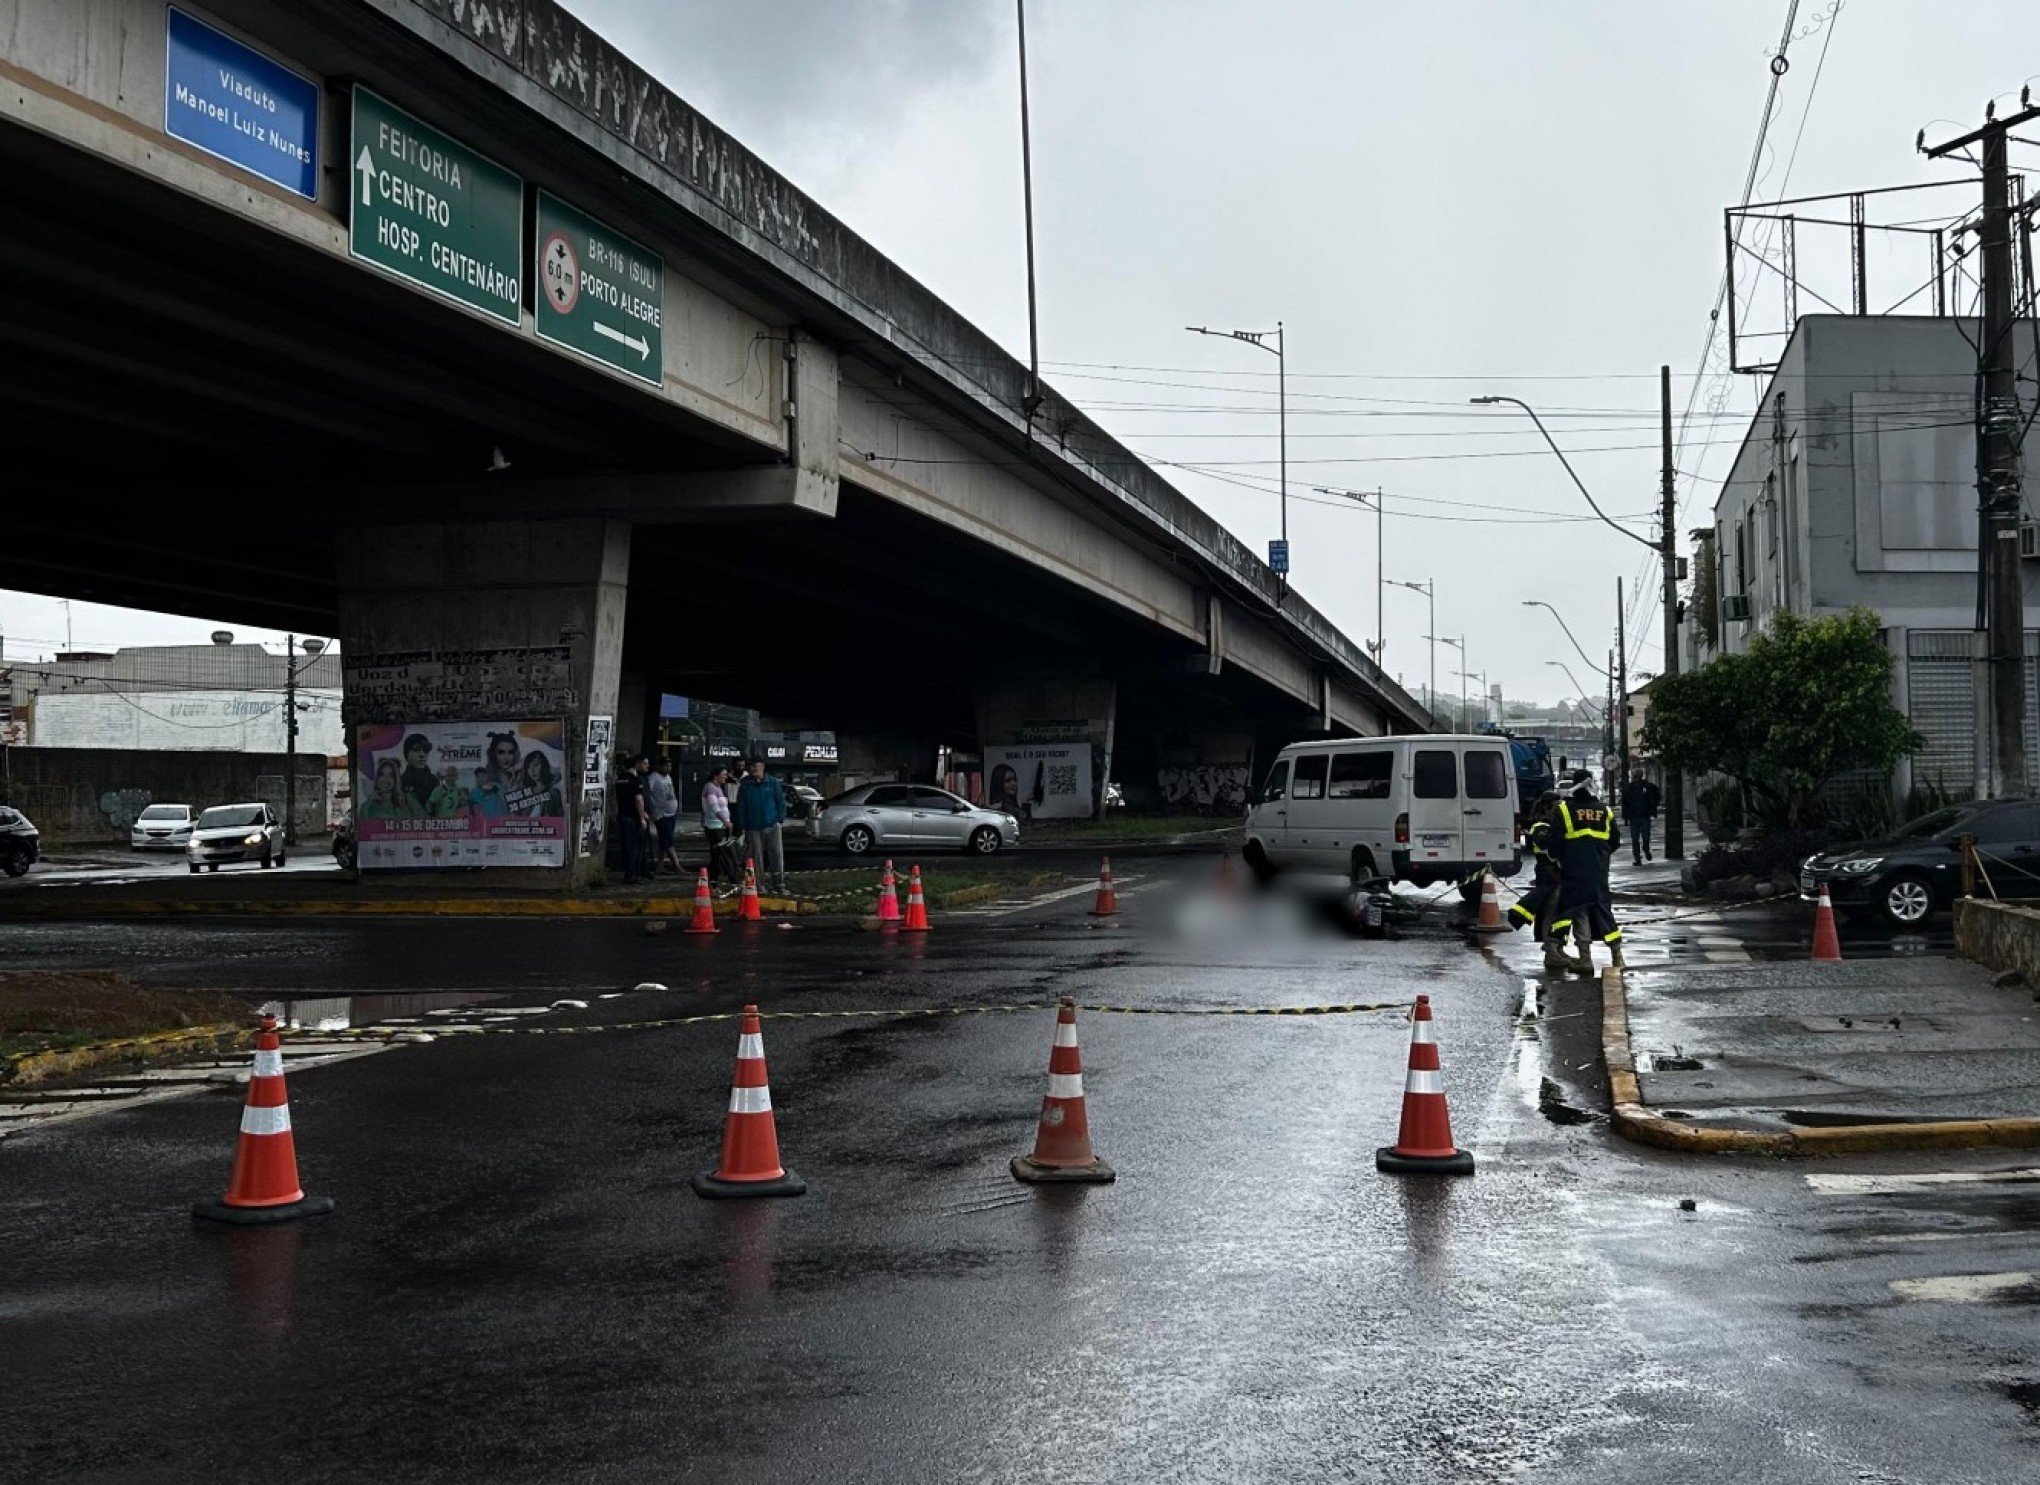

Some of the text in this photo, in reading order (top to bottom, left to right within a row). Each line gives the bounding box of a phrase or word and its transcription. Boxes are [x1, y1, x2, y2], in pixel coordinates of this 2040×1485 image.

[220, 69, 275, 112] Viaduto
[175, 82, 311, 164] Manoel Luiz Nunes
[379, 121, 461, 190] FEITORIA
[379, 170, 450, 228] CENTRO
[378, 216, 518, 303] HOSP. CENTENÁRIO
[589, 238, 656, 291] BR-116 (SUL)
[580, 270, 661, 328] PORTO ALEGRE
[402, 819, 411, 830] 15
[413, 819, 423, 831] DE
[425, 818, 470, 831] DEZEMBRO
[1576, 808, 1604, 822] PRF
